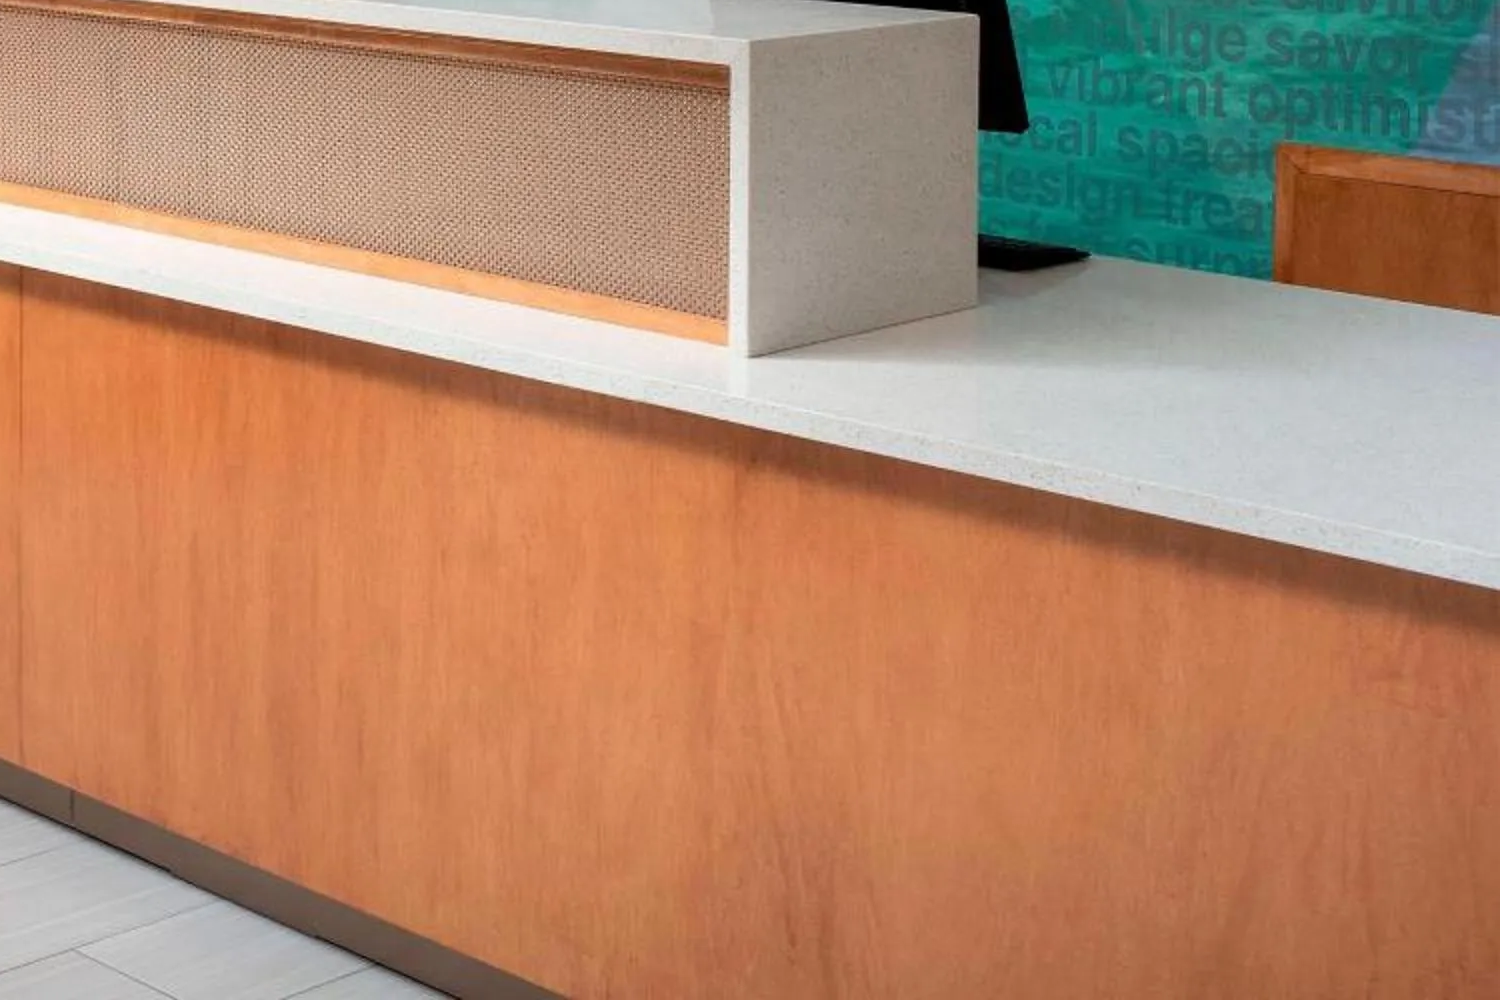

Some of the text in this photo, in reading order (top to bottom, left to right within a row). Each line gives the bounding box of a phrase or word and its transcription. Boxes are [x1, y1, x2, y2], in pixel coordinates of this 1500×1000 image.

[1047, 48, 1227, 117] vibrant
[1264, 26, 1429, 79] savor
[977, 147, 1144, 232] design
